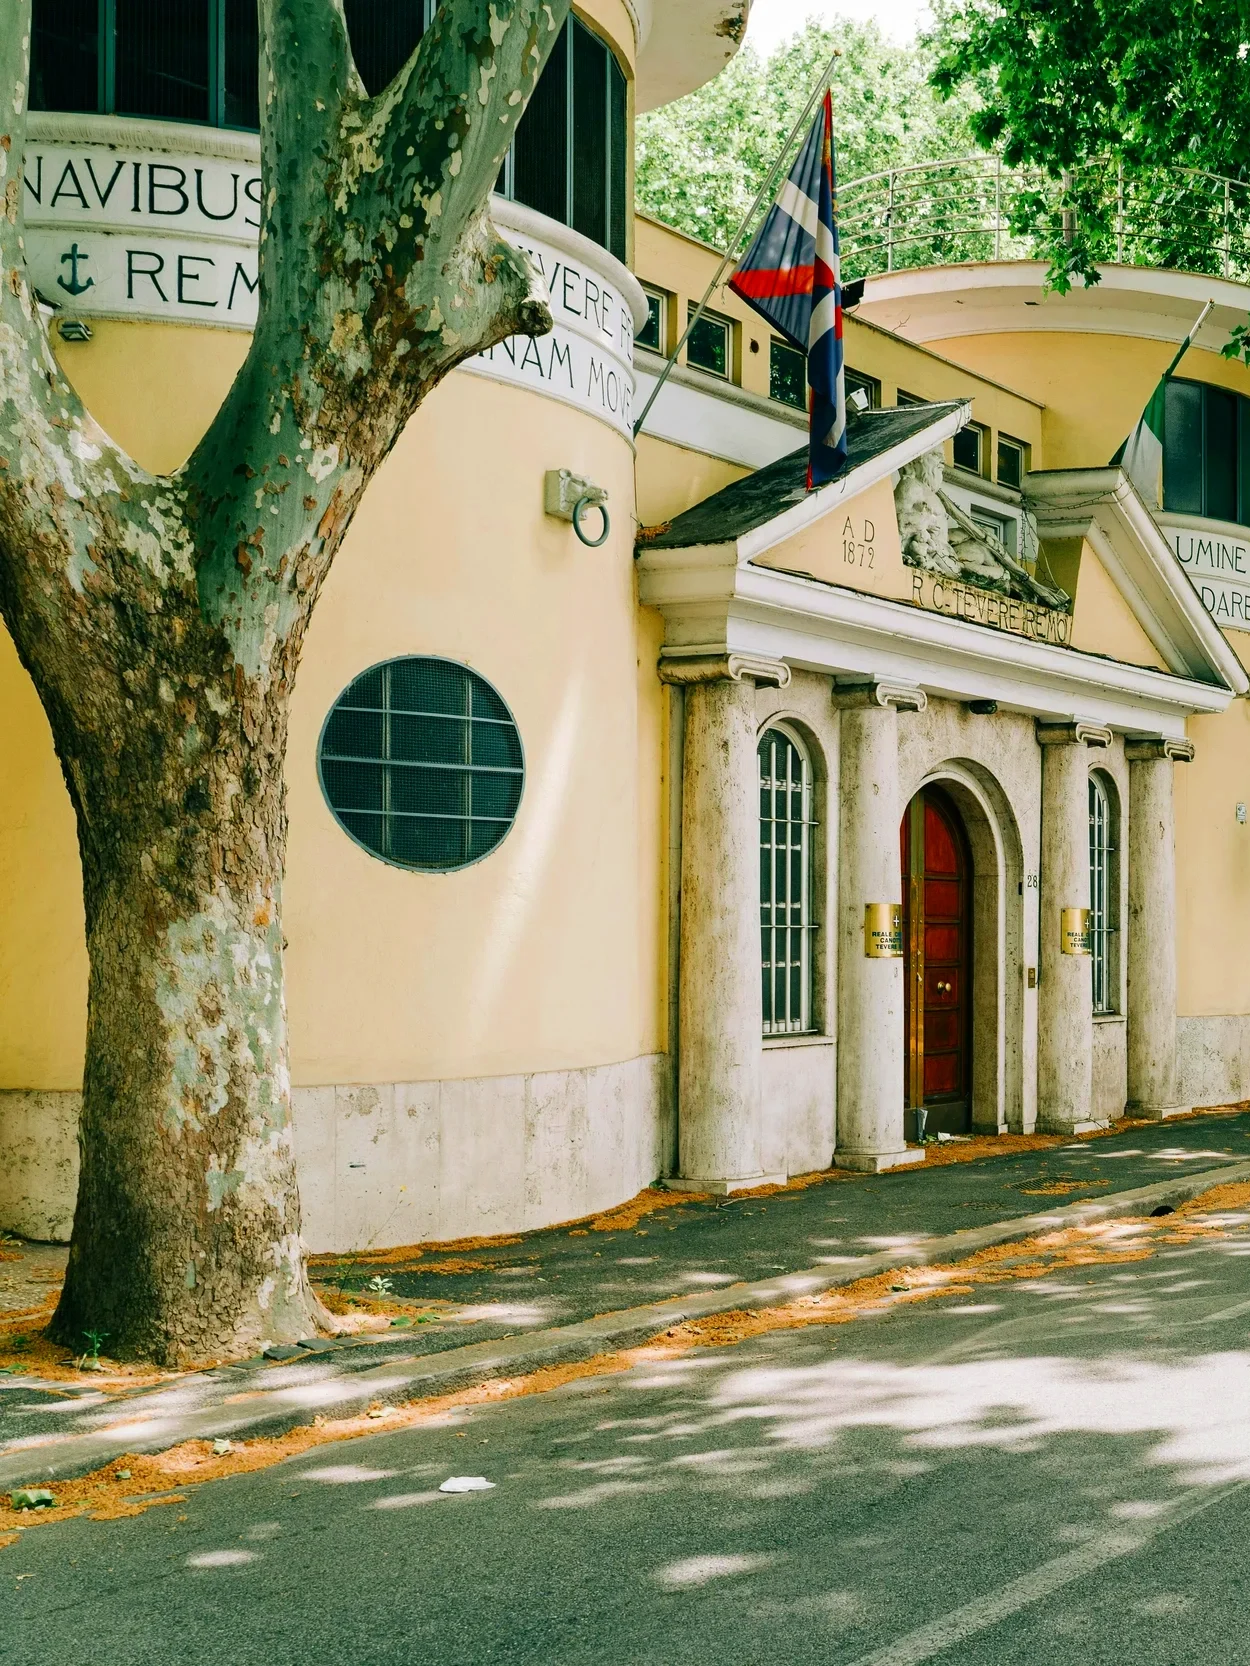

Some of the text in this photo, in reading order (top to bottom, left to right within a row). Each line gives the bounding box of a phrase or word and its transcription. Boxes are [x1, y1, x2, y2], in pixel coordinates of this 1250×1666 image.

[842, 515, 875, 543] A D
[841, 539, 875, 570] 1872
[1175, 535, 1247, 574] UMINE
[1027, 874, 1038, 888] 28
